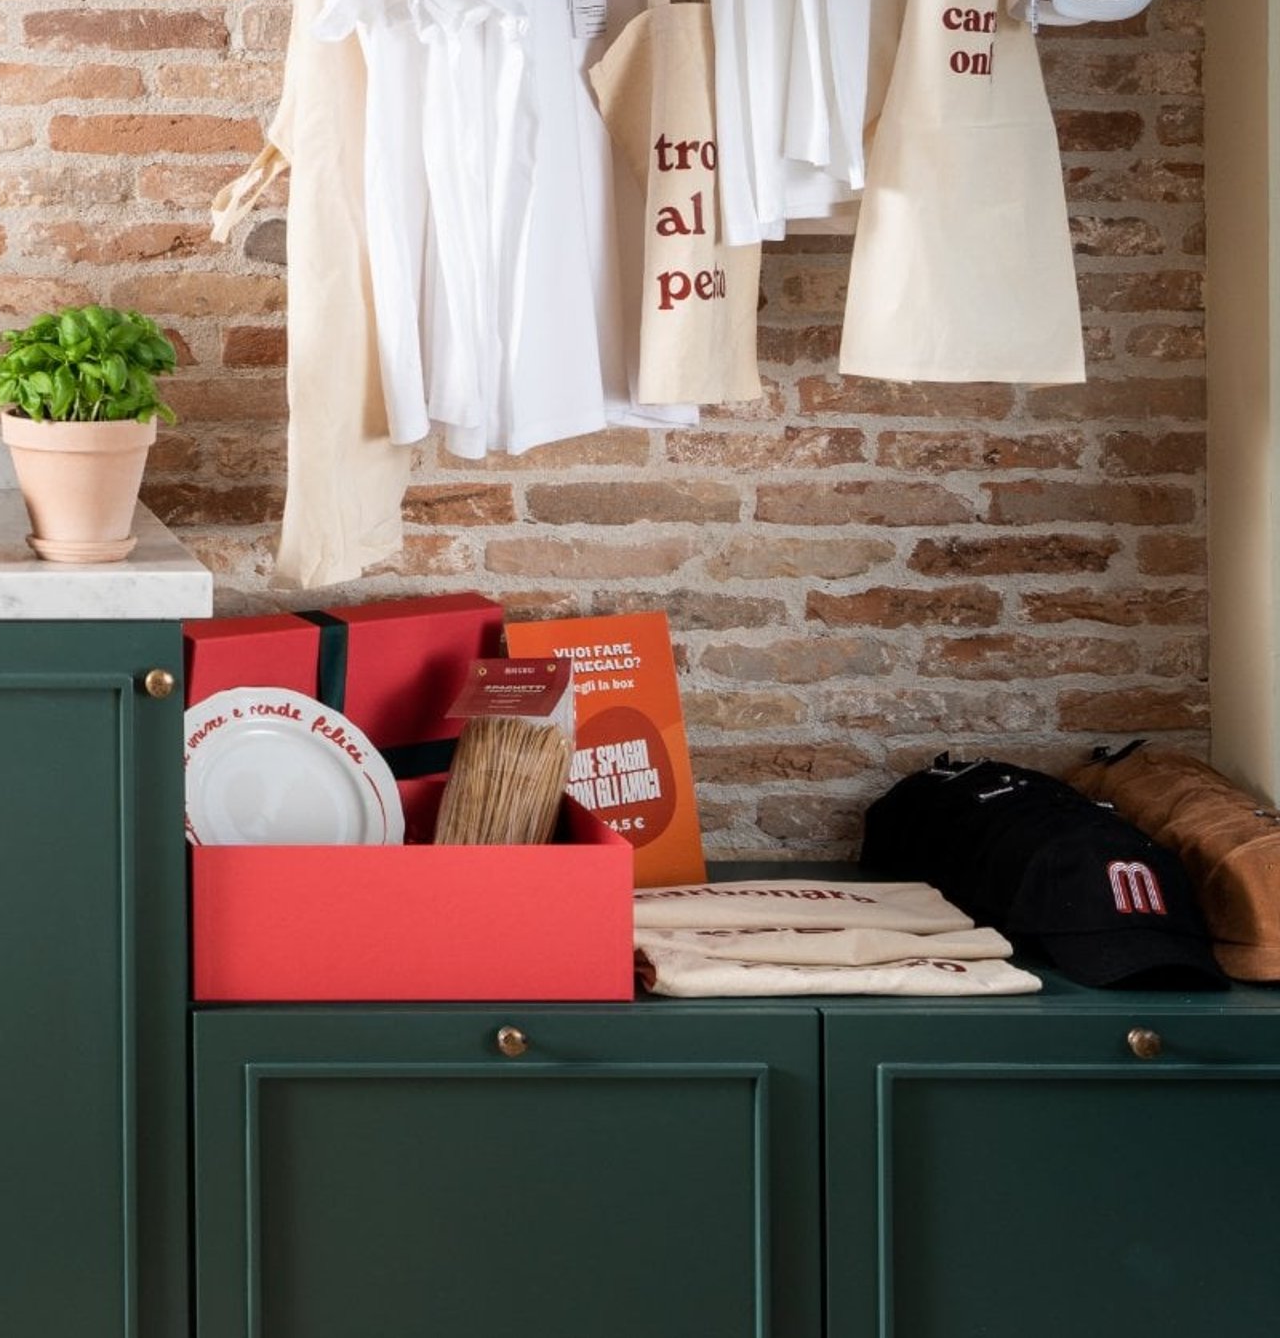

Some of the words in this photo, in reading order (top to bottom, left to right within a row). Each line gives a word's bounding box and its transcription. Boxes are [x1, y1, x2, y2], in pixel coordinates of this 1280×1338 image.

[942, 7, 998, 34] car
[656, 190, 706, 237] al
[554, 646, 591, 659] VUOI
[595, 643, 633, 657] FARE
[573, 657, 641, 673] REGALO?
[598, 680, 611, 691] la
[612, 678, 635, 690] box
[232, 708, 244, 718] e
[250, 702, 304, 722] rende
[596, 739, 650, 776] SPAGHI
[596, 774, 620, 808] GLI
[621, 768, 662, 804] AMICI
[603, 819, 631, 832] 4,5
